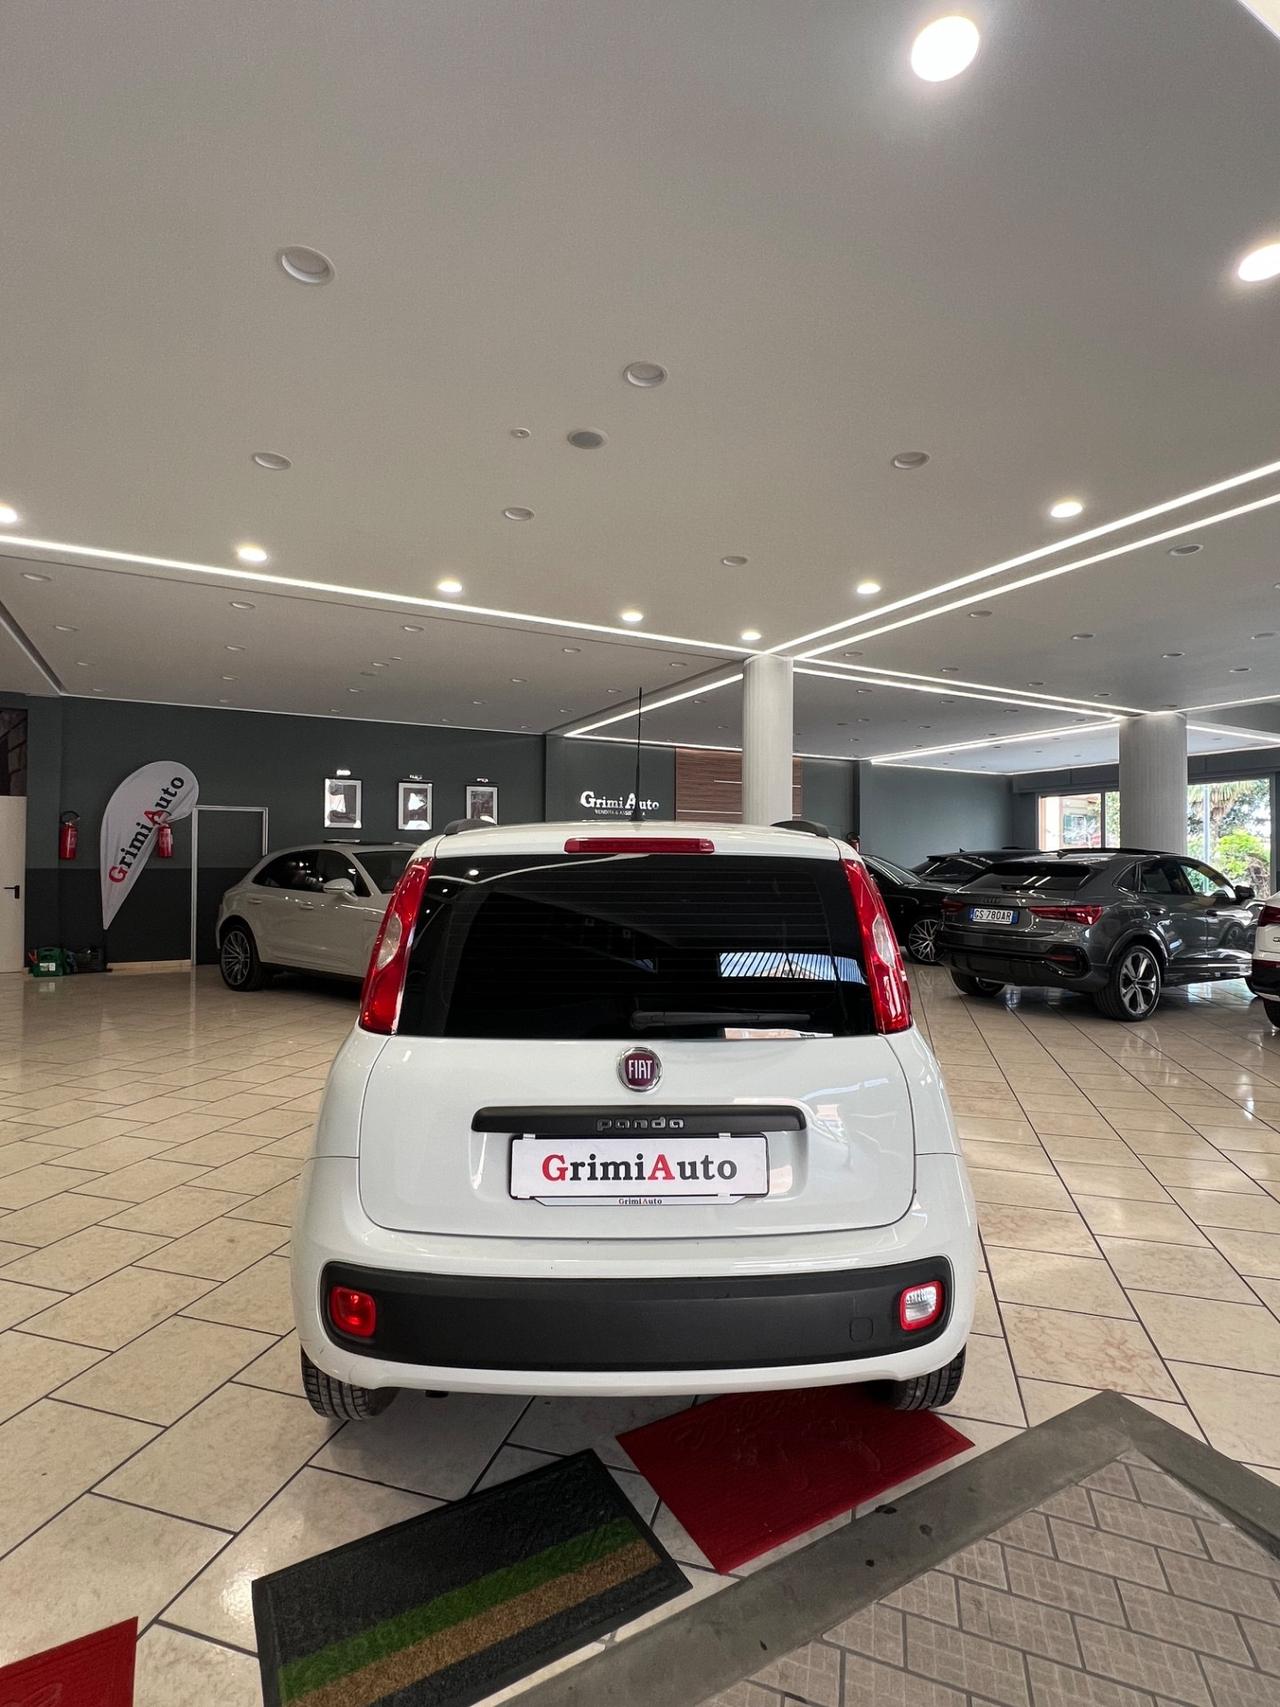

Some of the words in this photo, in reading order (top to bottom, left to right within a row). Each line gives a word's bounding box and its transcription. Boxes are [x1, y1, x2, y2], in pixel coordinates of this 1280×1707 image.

[109, 777, 184, 882] GrimiAuto
[628, 1059, 653, 1079] FIAT
[596, 1116, 685, 1131] panda
[541, 1153, 738, 1181] GrimiAuto
